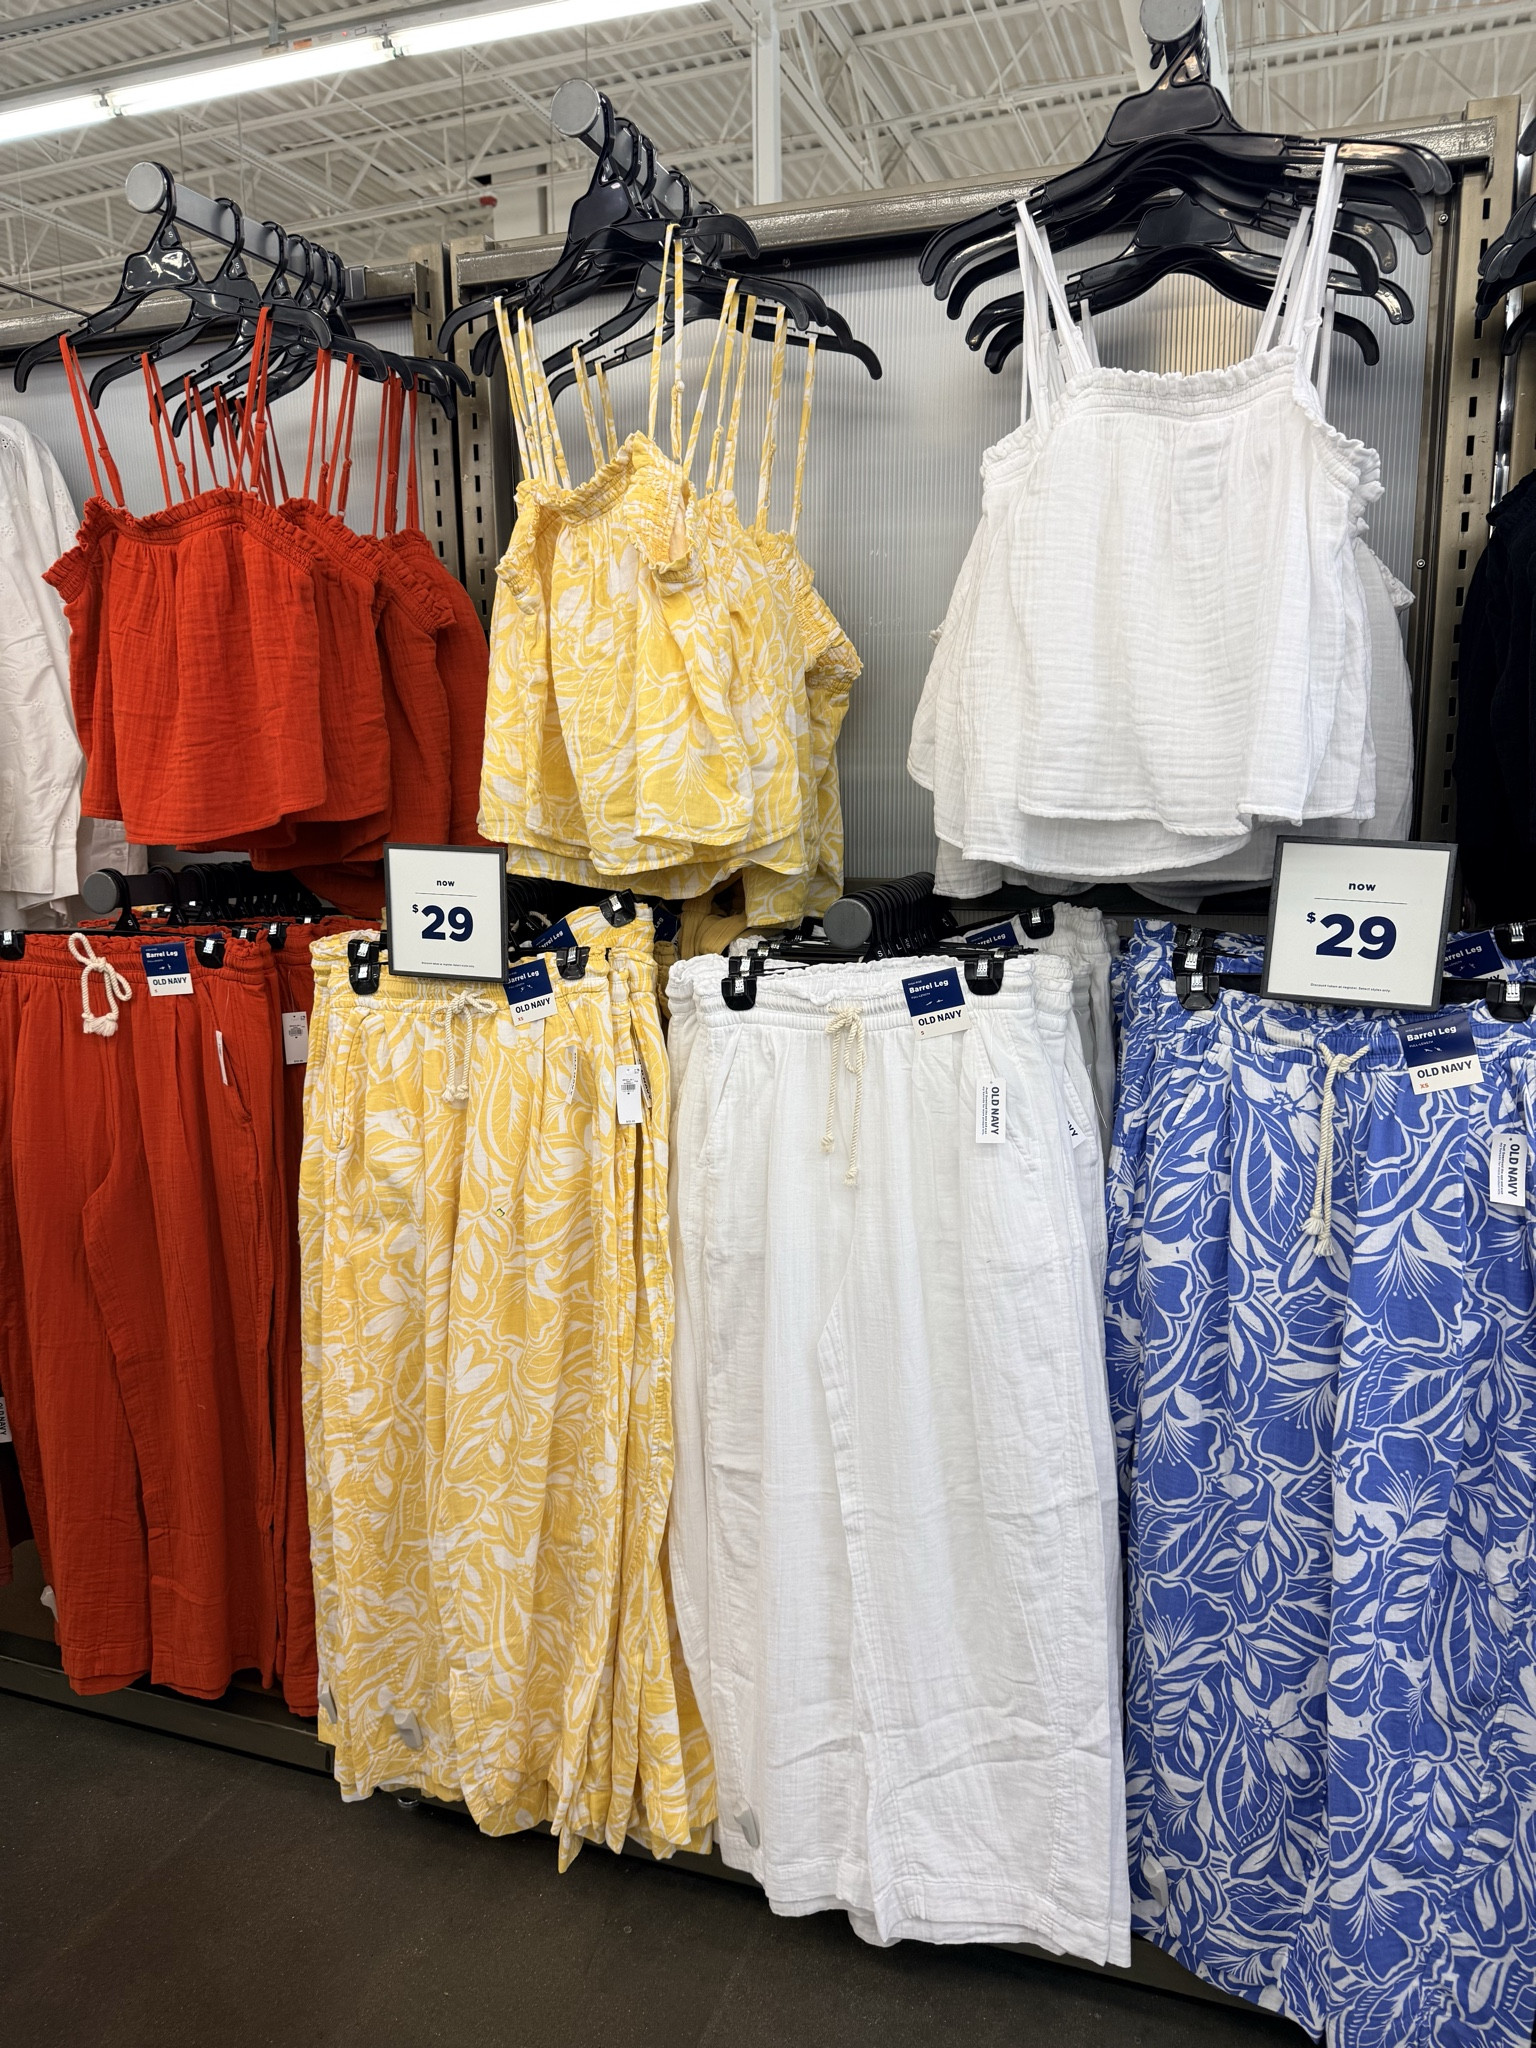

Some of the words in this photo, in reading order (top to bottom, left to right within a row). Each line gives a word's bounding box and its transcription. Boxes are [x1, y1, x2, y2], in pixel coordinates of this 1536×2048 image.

[168, 230, 174, 238] S
[436, 879, 455, 887] now
[1348, 882, 1377, 892] now
[993, 933, 1006, 942] Leg
[145, 950, 166, 959] Barrel
[877, 950, 884, 958] S
[1444, 950, 1464, 962] arrel
[1465, 945, 1482, 955] Leg
[152, 978, 167, 986] OLD
[168, 976, 187, 985] NAVY
[526, 970, 540, 978] Leg
[909, 982, 933, 994] Barrel
[934, 979, 949, 988] Leg
[515, 1003, 530, 1014] OLD
[531, 997, 551, 1010] NAVY
[918, 1016, 936, 1026] OLD
[937, 1009, 962, 1022] NAVY
[1406, 1029, 1436, 1042] Barrel
[1438, 1026, 1457, 1035] Leg
[1417, 1067, 1439, 1079] OLD
[1441, 1060, 1472, 1074] NAVY
[991, 1086, 1000, 1106] OLD
[990, 1108, 999, 1135] NAVY
[1509, 1144, 1520, 1165] OLD
[1508, 1167, 1518, 1197] NAVY
